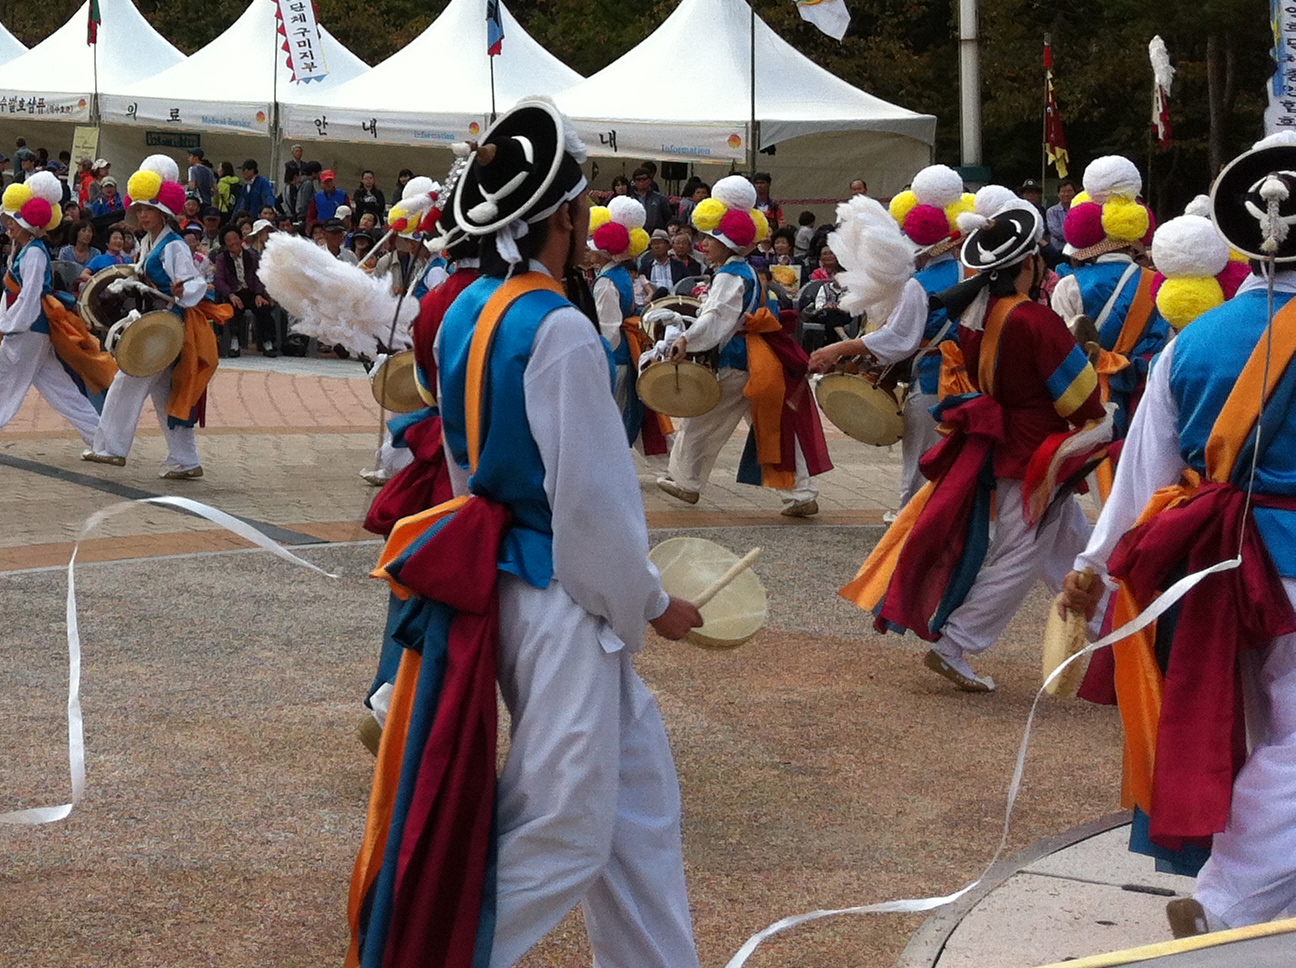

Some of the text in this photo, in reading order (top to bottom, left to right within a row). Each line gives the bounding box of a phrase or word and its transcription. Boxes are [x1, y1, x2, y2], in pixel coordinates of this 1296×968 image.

[293, 27, 317, 73] 구미지부
[202, 115, 251, 128] Medical Service
[413, 130, 455, 141] Information
[599, 130, 617, 153] 내
[661, 144, 711, 155] Information
